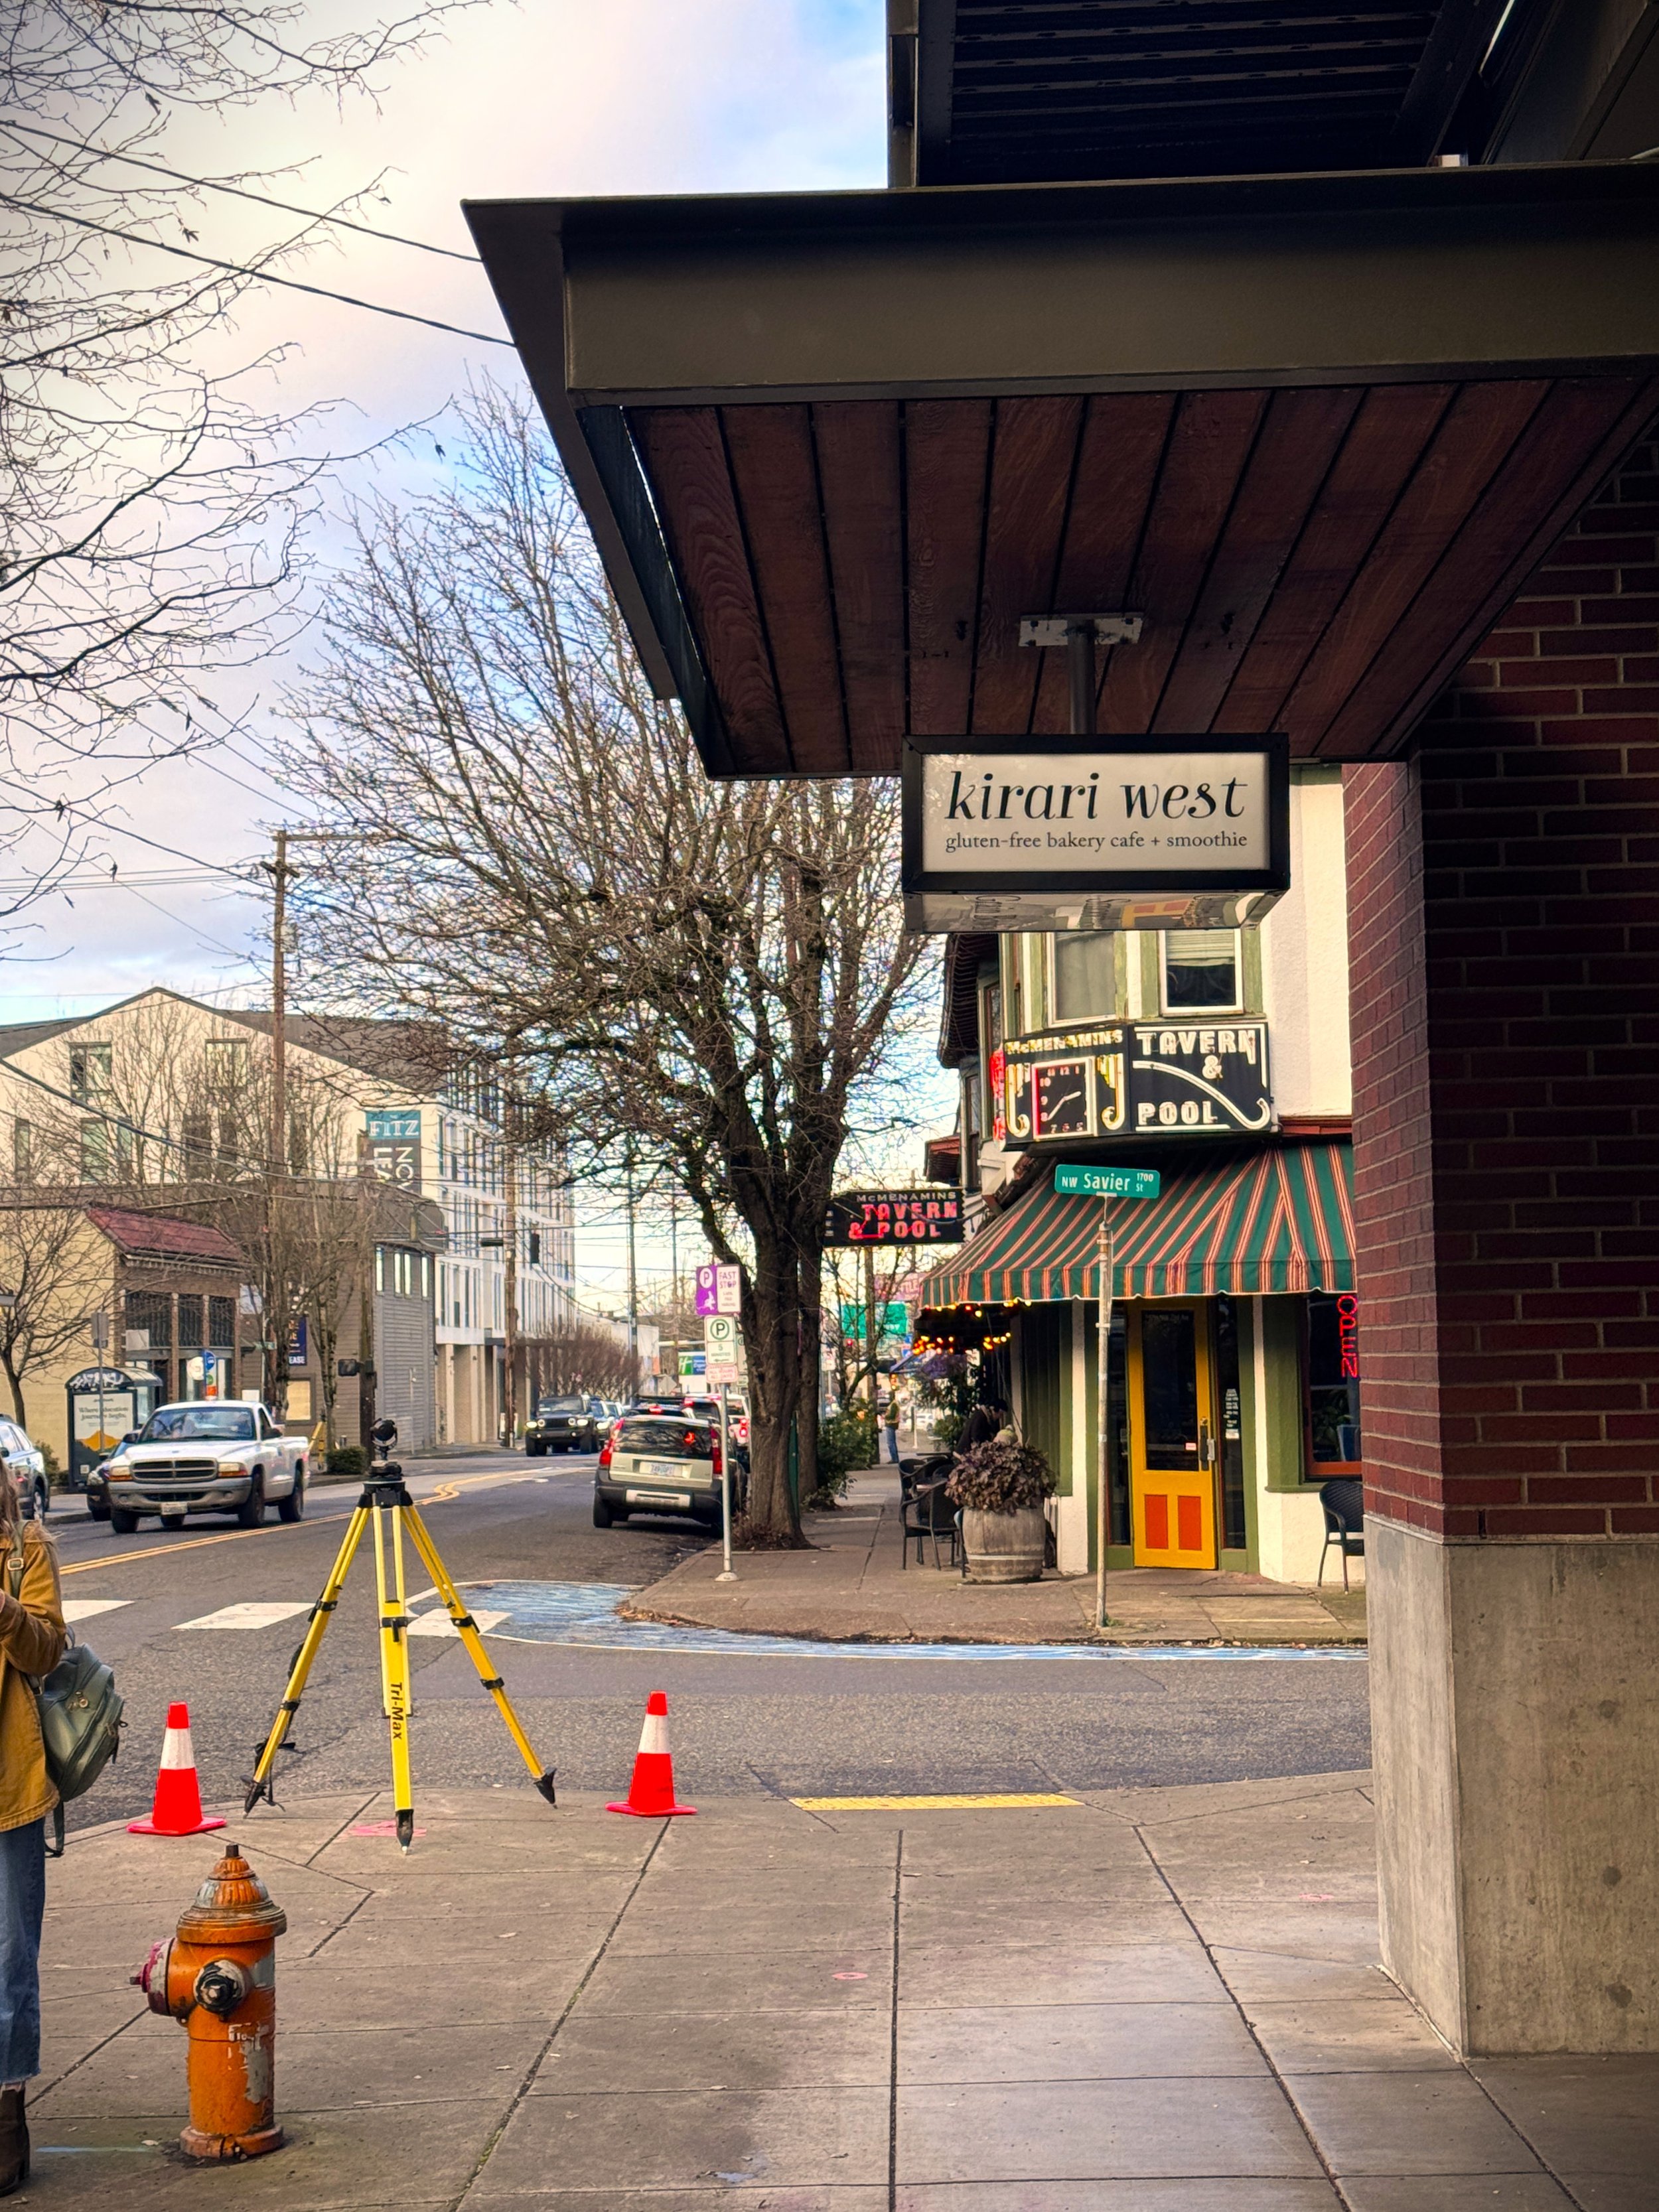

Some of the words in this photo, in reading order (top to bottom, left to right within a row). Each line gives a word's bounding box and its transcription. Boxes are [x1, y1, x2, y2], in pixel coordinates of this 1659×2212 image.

[944, 770, 1100, 821] kirari
[1119, 776, 1248, 820] west
[945, 831, 1041, 854] gluten-free
[1047, 831, 1106, 853] bakery
[1110, 831, 1145, 848] cafe
[1150, 837, 1160, 847] +
[1166, 830, 1248, 848] smoothie
[1135, 1030, 1256, 1065] TAVERN
[1202, 1055, 1223, 1079] &
[1137, 1101, 1218, 1125] POOL
[368, 1119, 419, 1137] FITZ
[1062, 1176, 1078, 1188] NW
[1084, 1173, 1131, 1192] Savier
[1135, 1183, 1144, 1192] St
[1136, 1172, 1155, 1182] 1700
[861, 1202, 957, 1221] TAVERN
[849, 1221, 863, 1239] &
[877, 1220, 942, 1239] POOL
[703, 1271, 710, 1285] P
[719, 1271, 737, 1280] FAST
[719, 1280, 737, 1289] STOP
[716, 1322, 725, 1336] P
[1336, 1294, 1358, 1378] OPEN
[288, 1355, 306, 1365] EASE
[390, 1682, 404, 1740] Tri-Max
